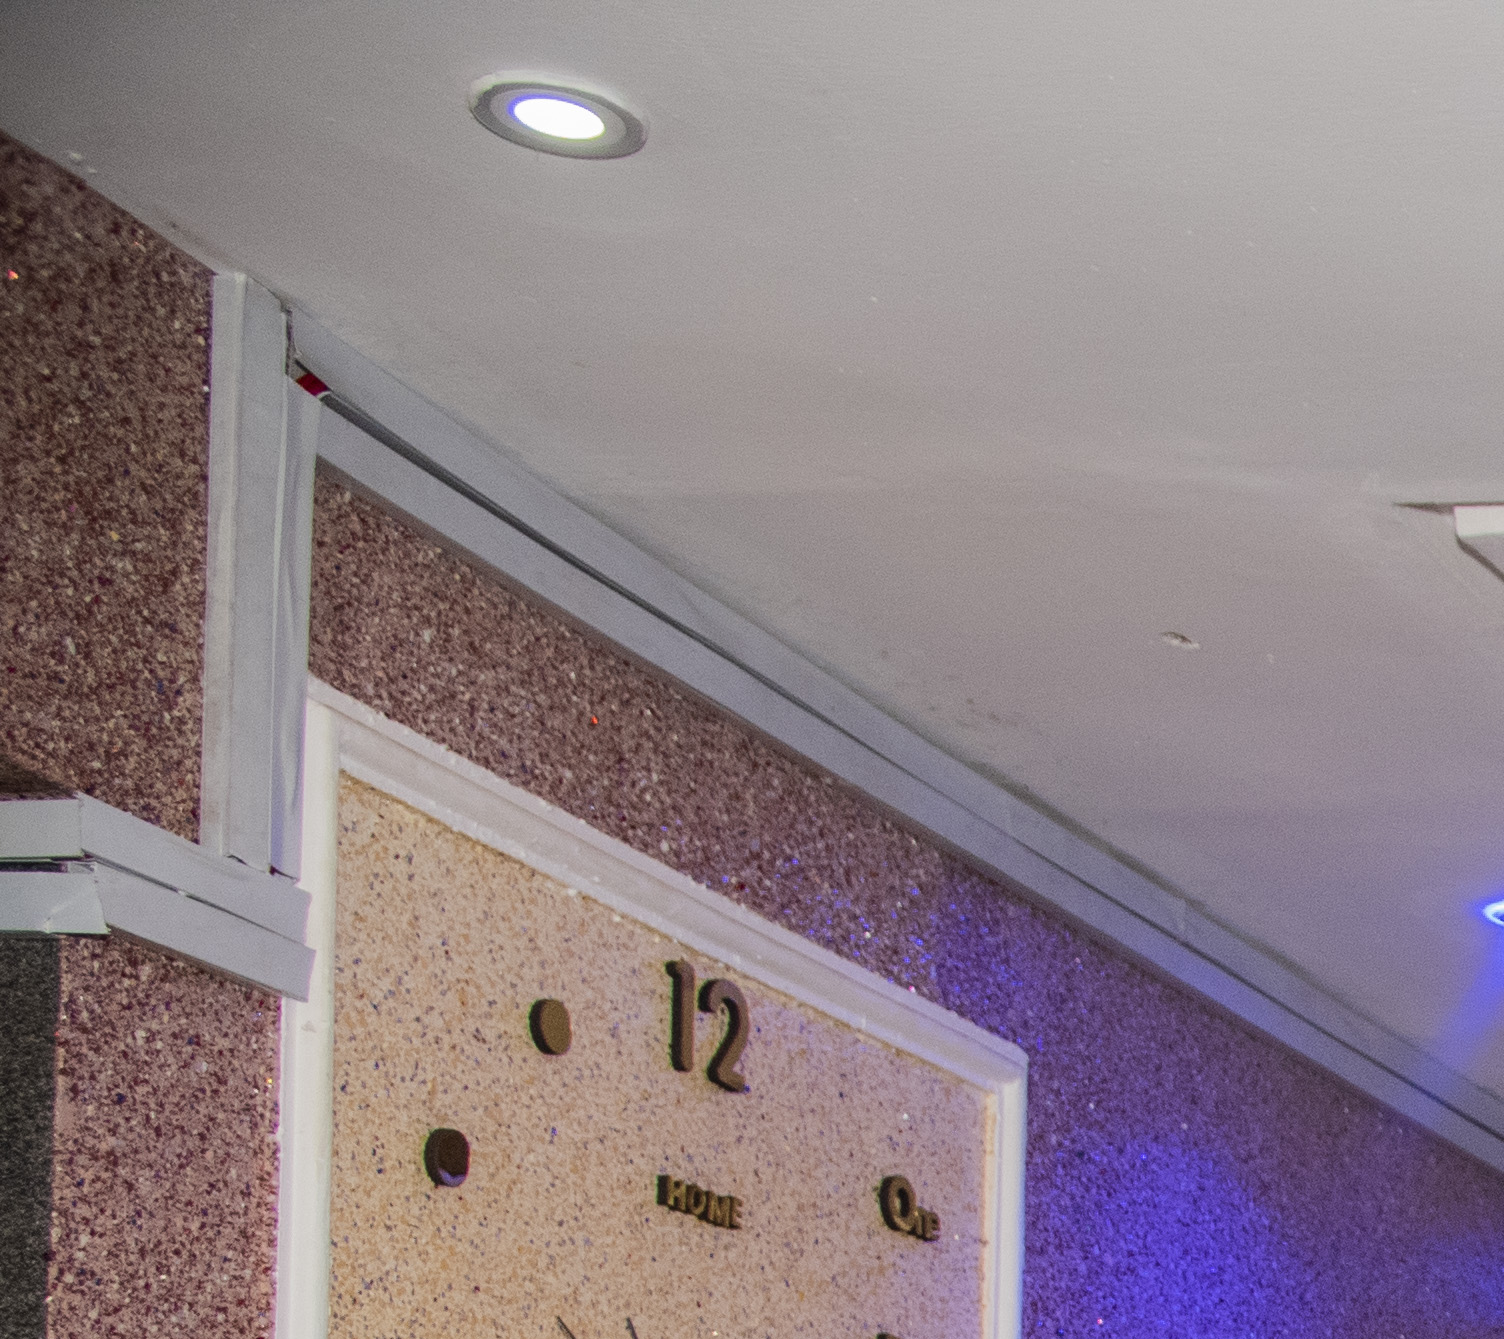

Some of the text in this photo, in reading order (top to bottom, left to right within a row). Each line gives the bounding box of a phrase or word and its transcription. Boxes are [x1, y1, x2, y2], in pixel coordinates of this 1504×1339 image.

[664, 958, 750, 1093] 12
[656, 1174, 744, 1231] HOME
[878, 1174, 942, 1243] One
